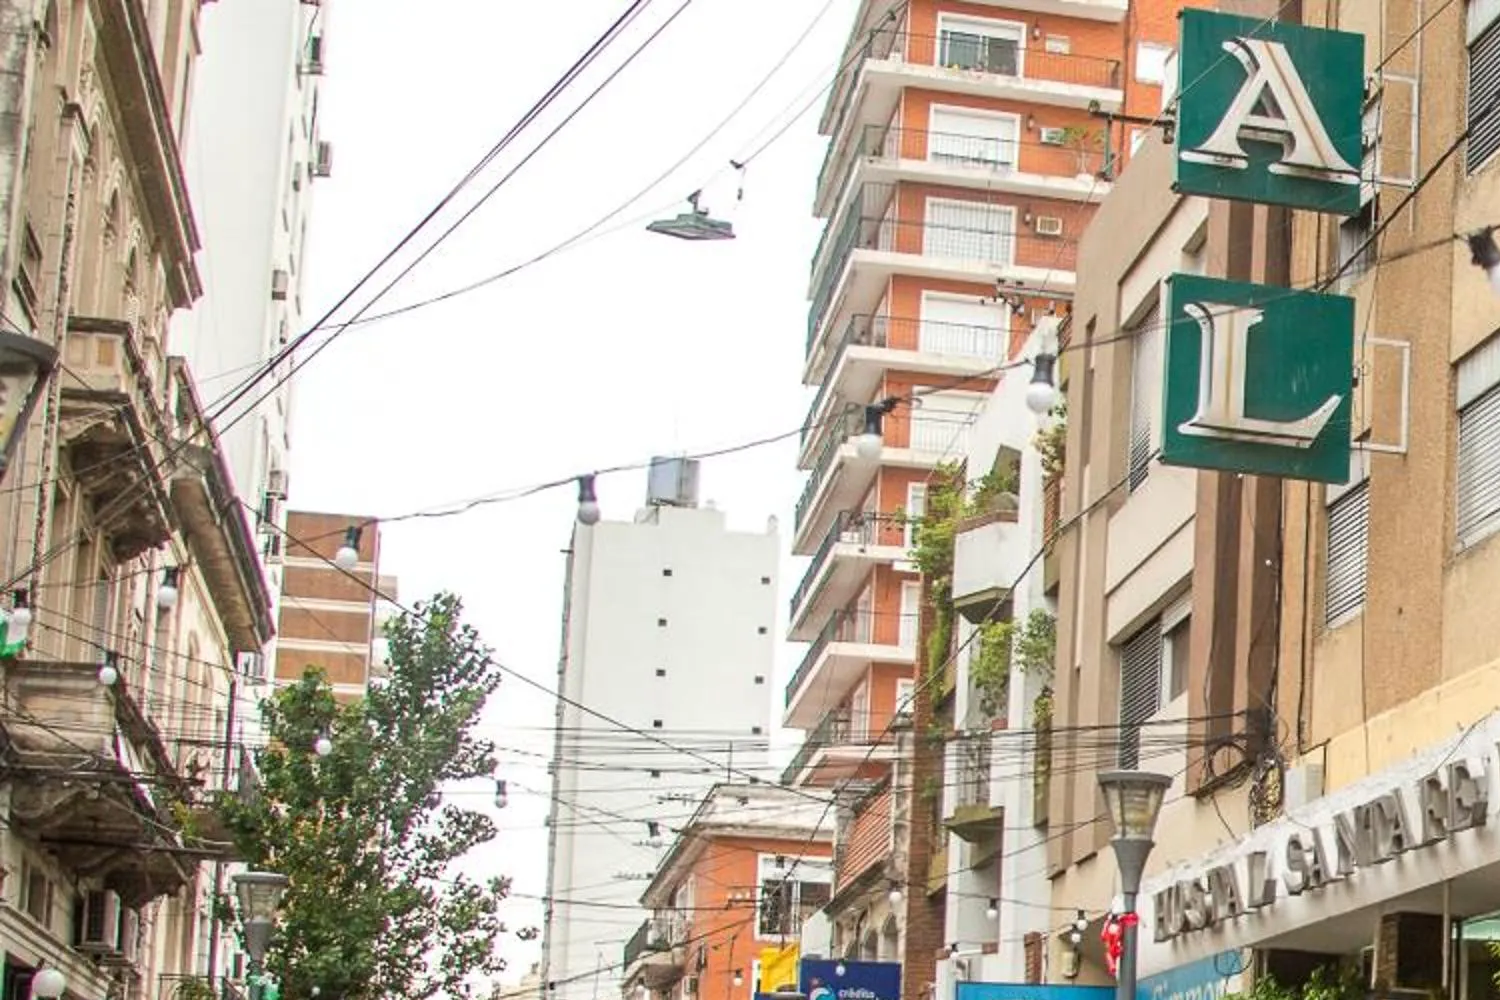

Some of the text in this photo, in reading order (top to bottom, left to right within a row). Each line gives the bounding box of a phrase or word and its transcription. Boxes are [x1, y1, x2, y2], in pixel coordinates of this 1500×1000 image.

[1153, 850, 1277, 944] HOSTAL
[1284, 787, 1418, 896] SANTA
[1419, 758, 1489, 848] FE
